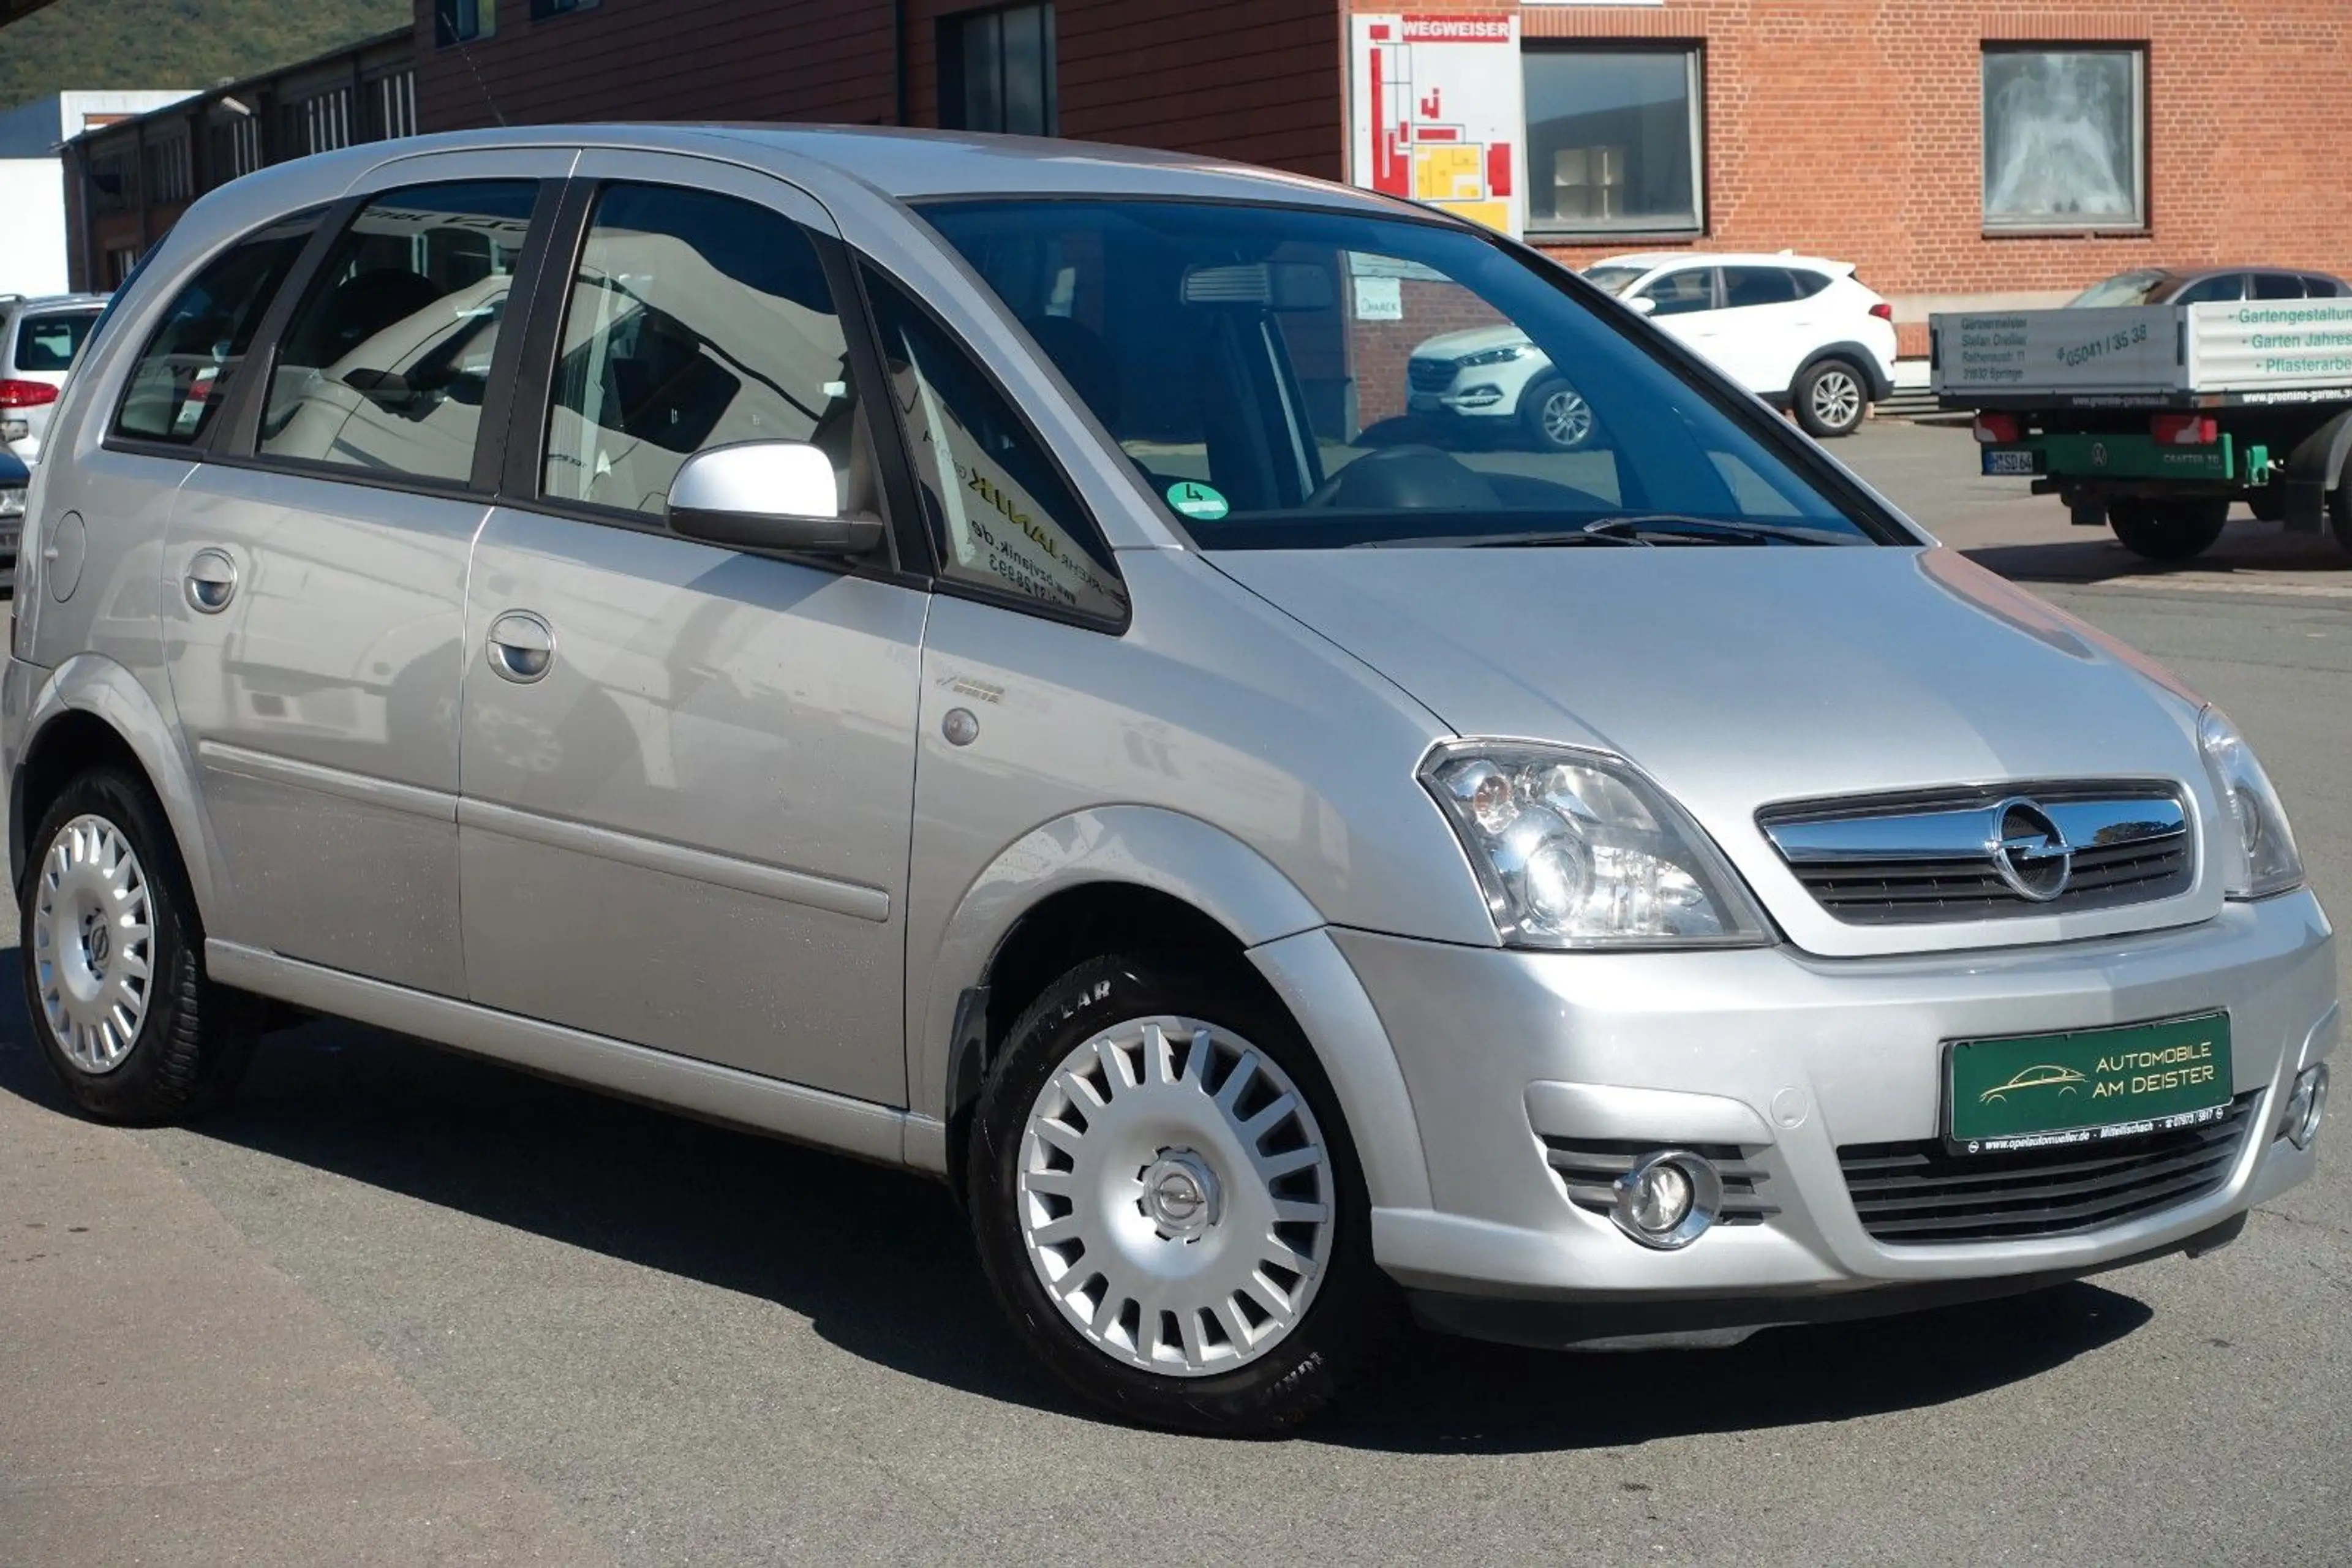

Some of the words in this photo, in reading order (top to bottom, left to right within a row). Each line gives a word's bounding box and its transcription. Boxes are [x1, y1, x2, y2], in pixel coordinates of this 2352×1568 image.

[1403, 21, 1510, 37] WEGWEISER
[2067, 341, 2101, 367] 05041
[2113, 331, 2129, 350] 35
[2132, 324, 2147, 344] 38
[2252, 334, 2301, 349] Garten
[1186, 483, 1203, 500] 4
[2096, 1041, 2212, 1073] AUTOMOBILE
[2092, 1080, 2124, 1098] AM
[2132, 1065, 2214, 1093] DEISTER
